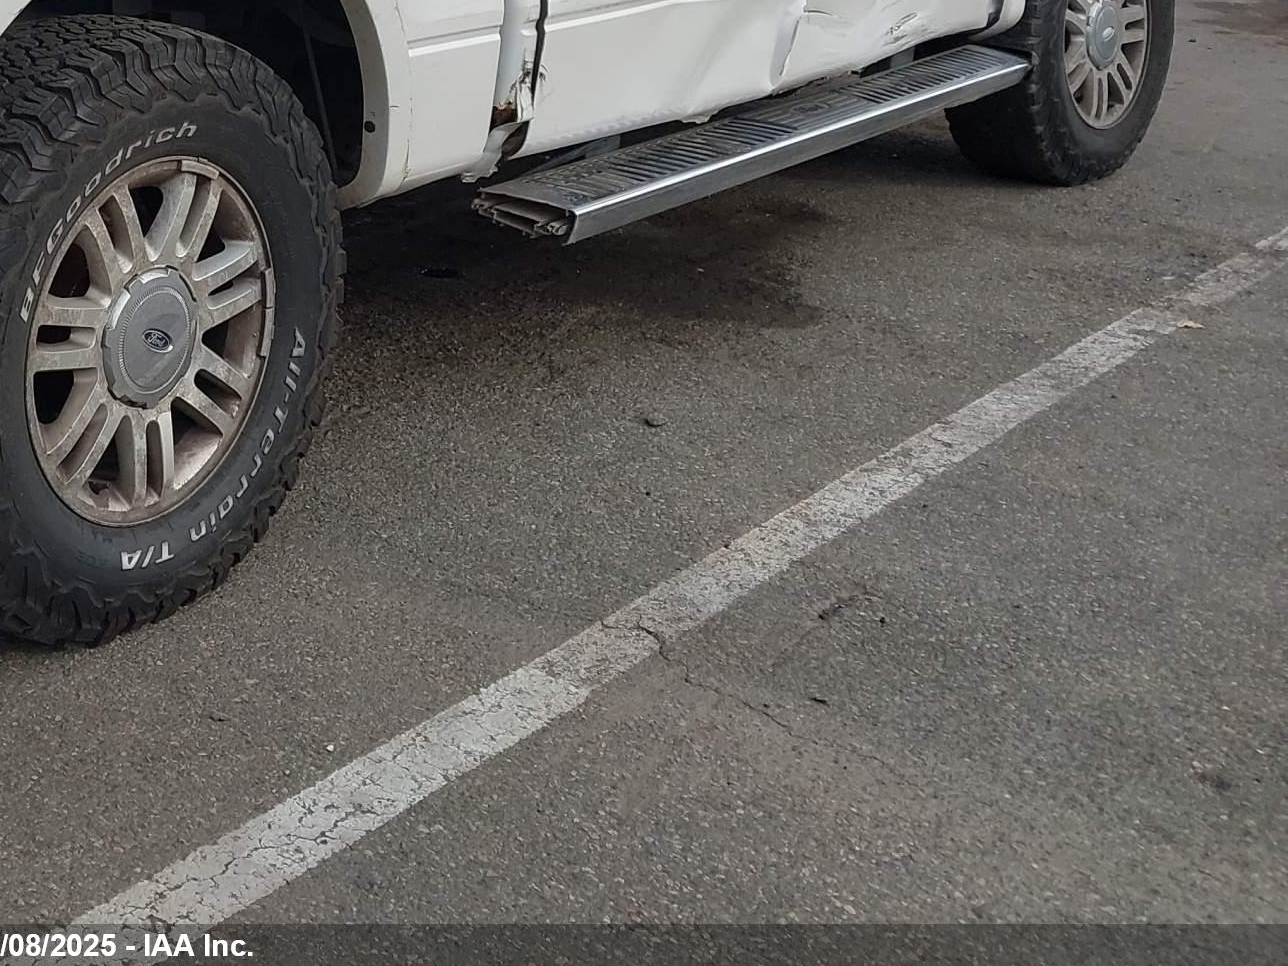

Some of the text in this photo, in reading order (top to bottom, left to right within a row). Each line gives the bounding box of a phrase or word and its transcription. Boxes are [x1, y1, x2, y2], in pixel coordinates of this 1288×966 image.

[20, 121, 198, 323] BFGoodrich
[119, 326, 307, 571] All-Terrain T/A
